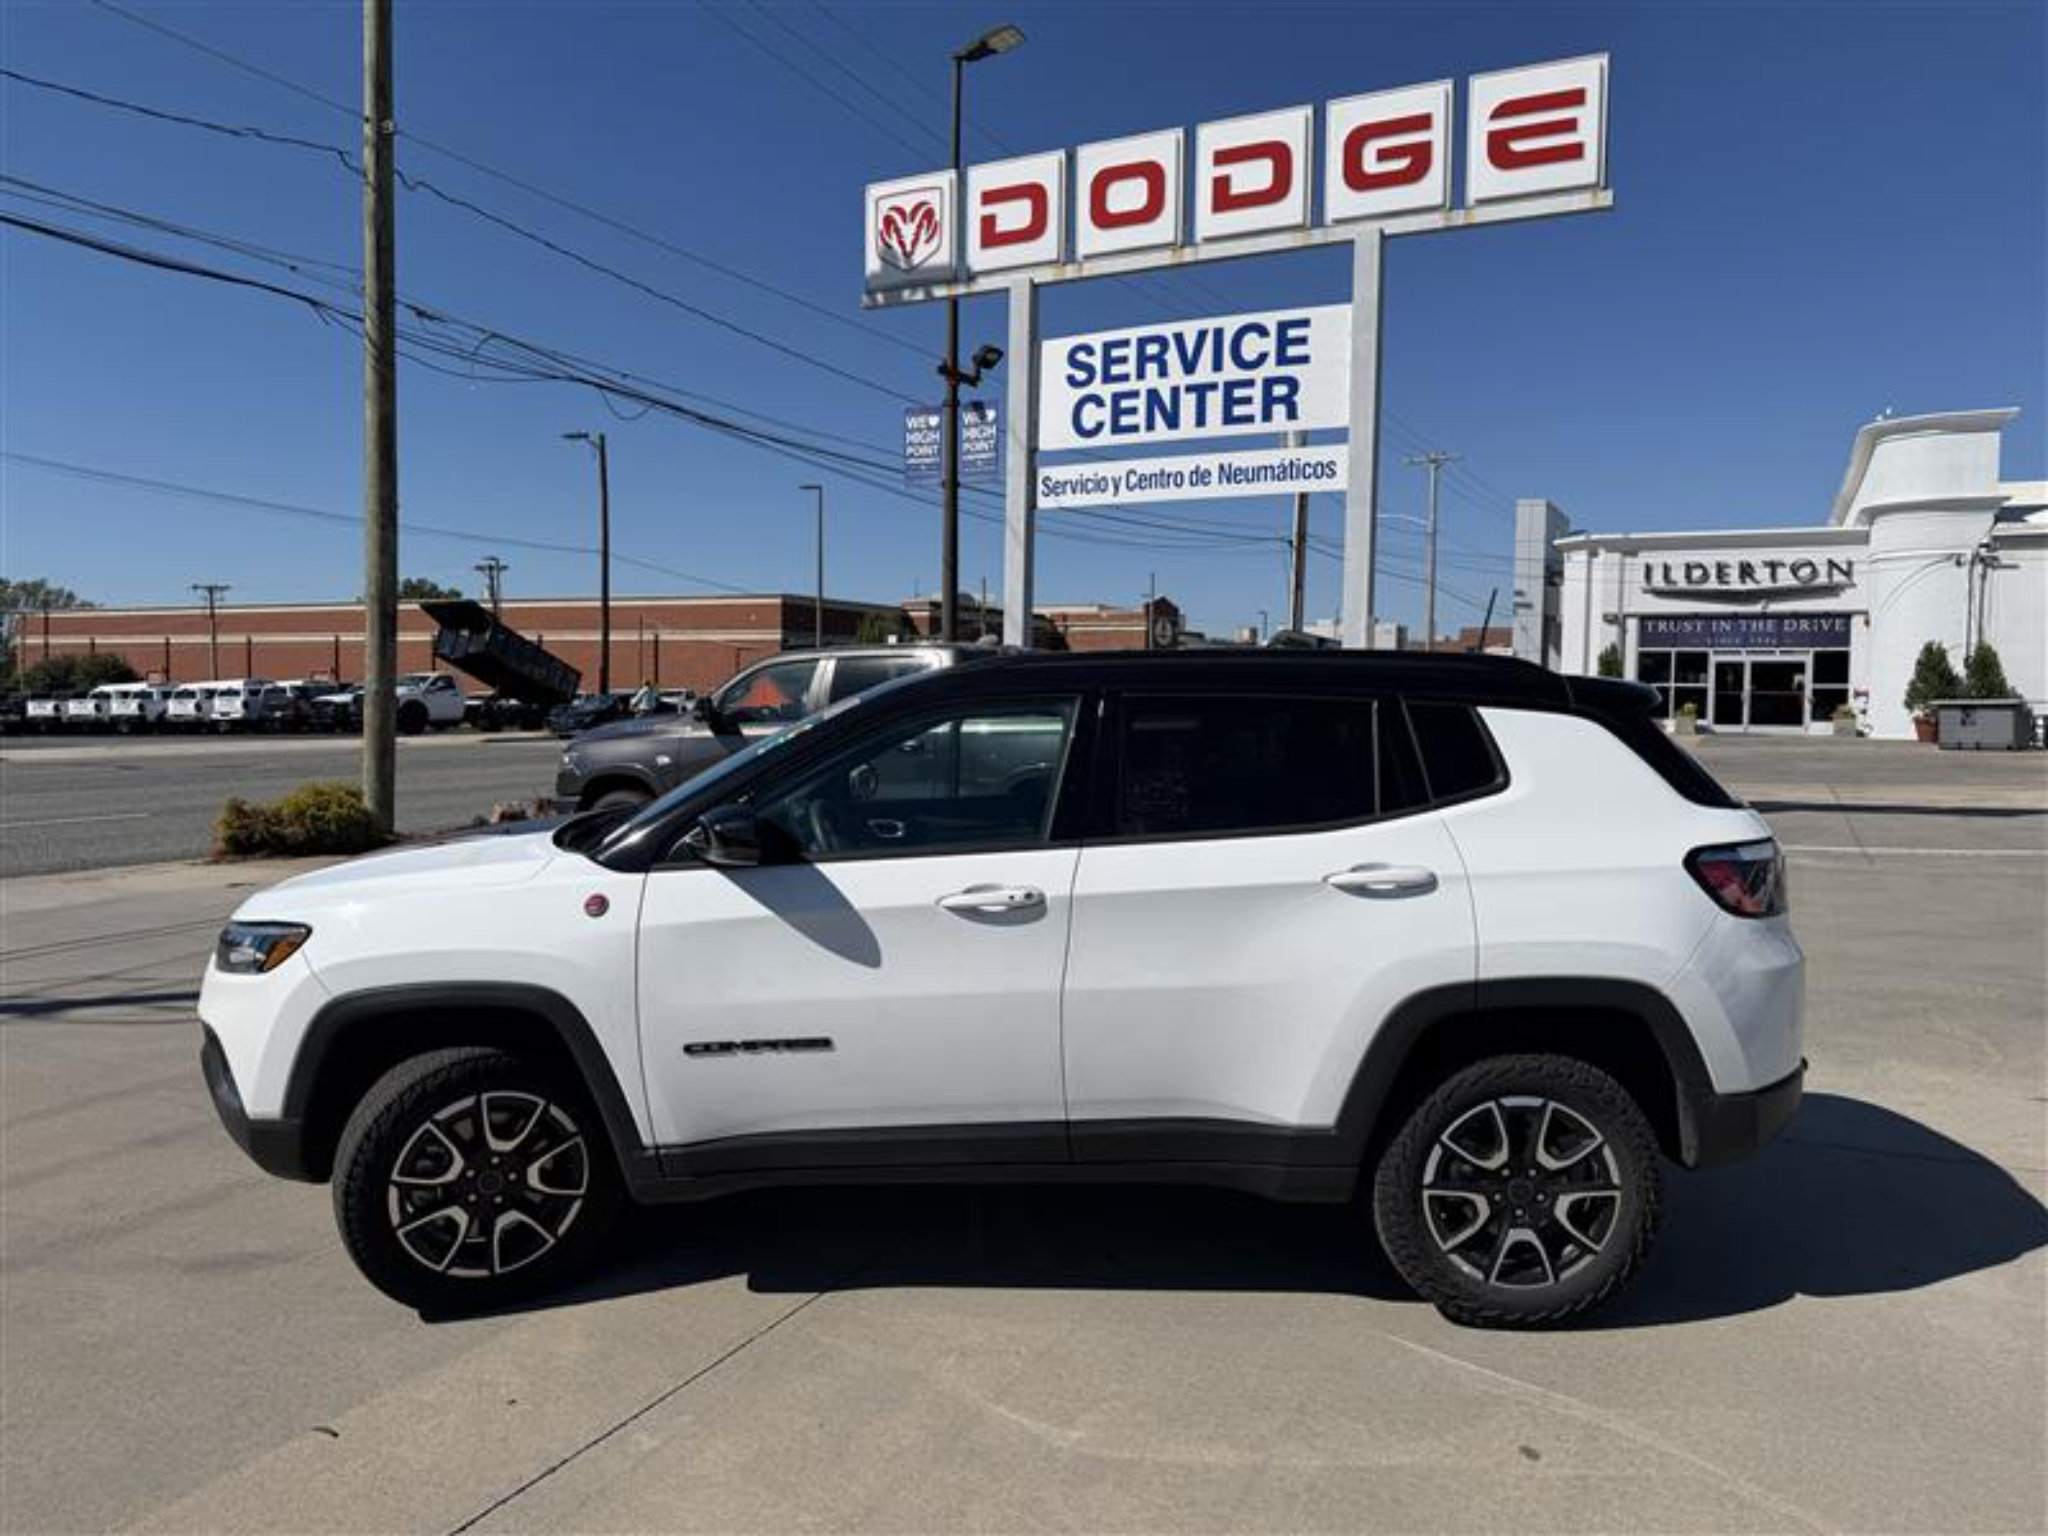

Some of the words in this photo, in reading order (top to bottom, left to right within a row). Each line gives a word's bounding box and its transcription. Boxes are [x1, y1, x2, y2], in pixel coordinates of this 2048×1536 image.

[980, 87, 1586, 250] DODGE
[1066, 318, 1311, 388] SERVICE
[1072, 376, 1300, 438] CENTER
[906, 445, 939, 457] POINT
[1041, 475, 1110, 498] Servicio
[1111, 474, 1122, 497] y
[1125, 466, 1185, 492] Centro
[1189, 464, 1212, 487] de
[1217, 457, 1338, 486] Neumáticos
[1643, 557, 1855, 586] ILDERTON
[1646, 619, 1703, 633] TRUST
[1712, 619, 1731, 632] IN
[1738, 618, 1777, 632] THE
[1783, 617, 1846, 632] DRIVE
